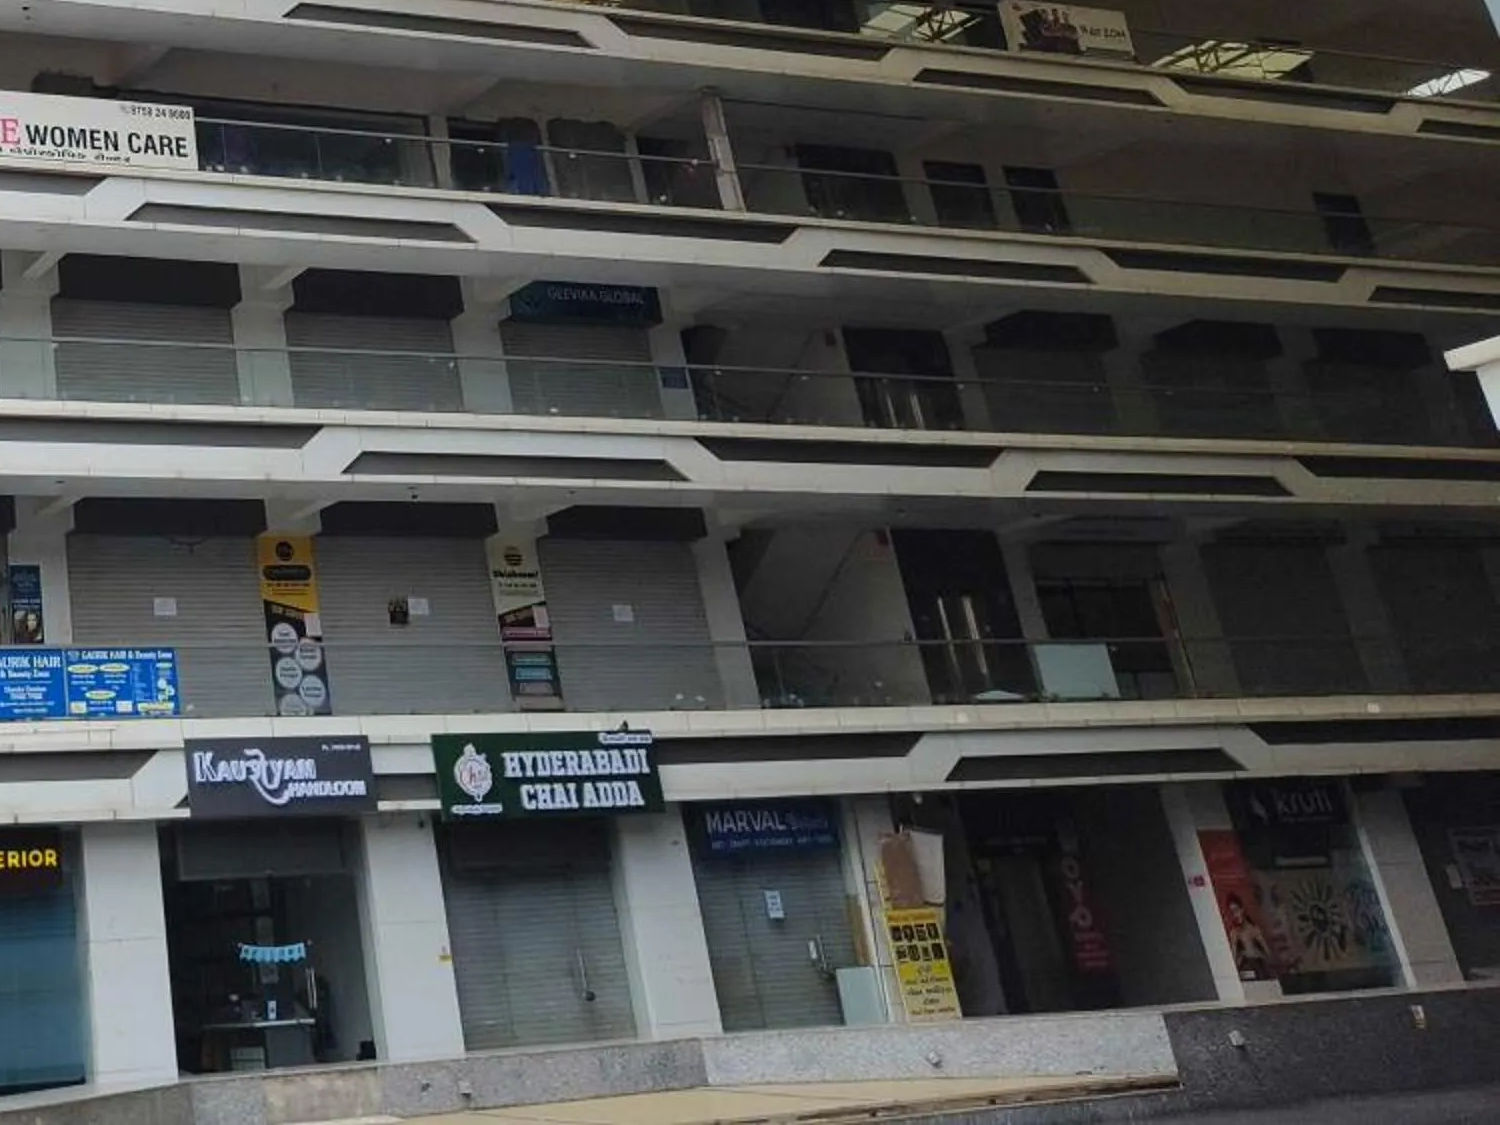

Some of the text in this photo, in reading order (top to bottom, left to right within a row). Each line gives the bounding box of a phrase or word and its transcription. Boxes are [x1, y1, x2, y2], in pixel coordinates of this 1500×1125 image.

[25, 122, 190, 159] WOMEN CARE
[33, 655, 62, 668] HAIR
[501, 748, 650, 778] HYDERABADI
[287, 780, 367, 797] HANDLOOM
[520, 780, 646, 811] CHAI ADDA
[704, 810, 788, 835] MARVAL
